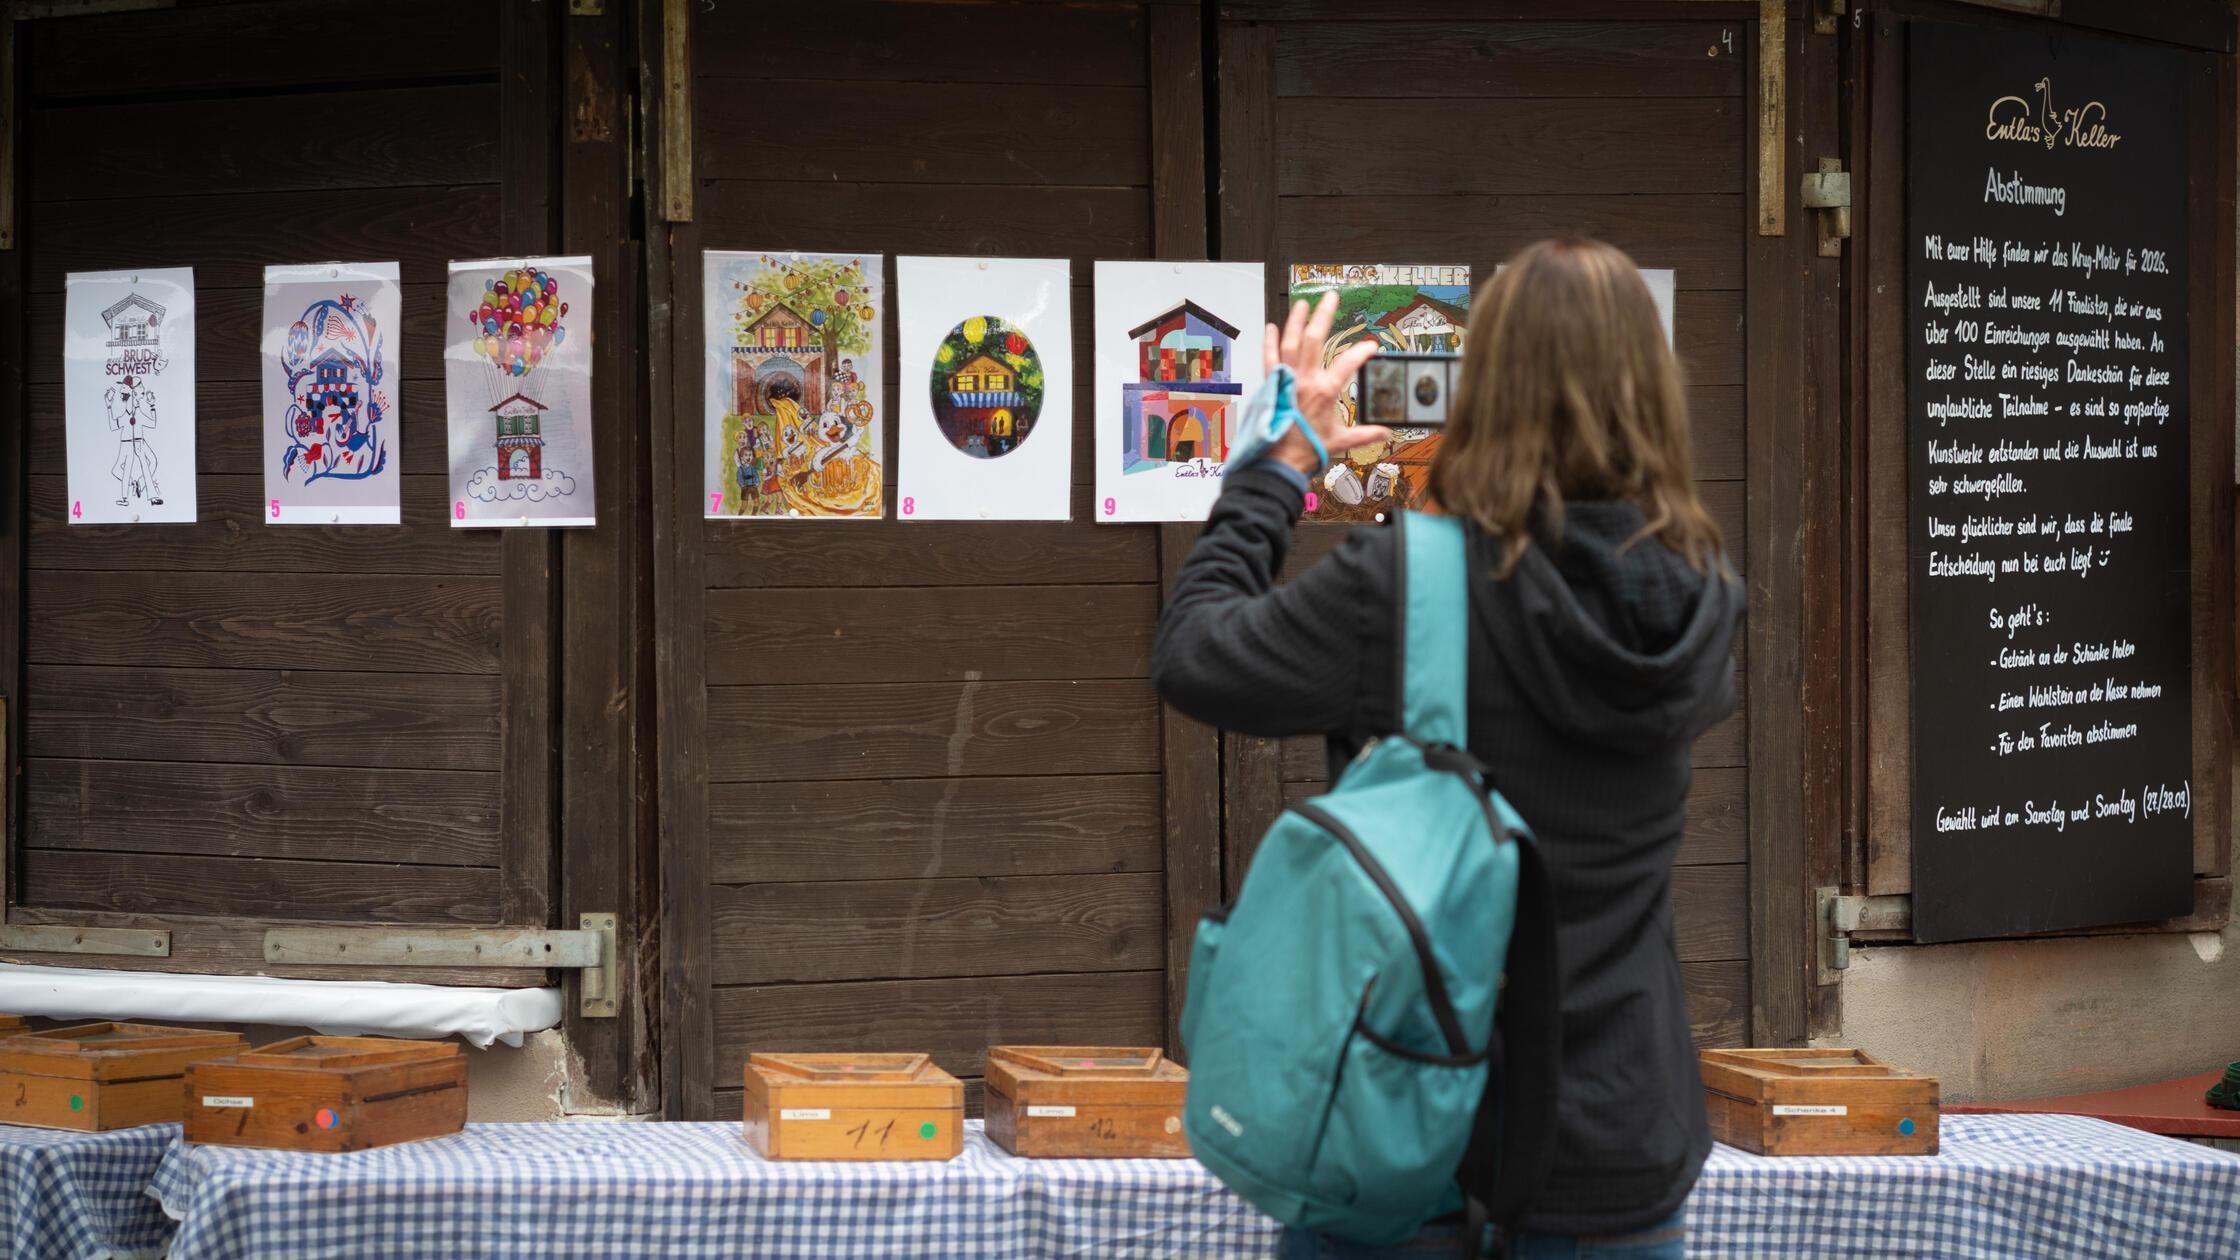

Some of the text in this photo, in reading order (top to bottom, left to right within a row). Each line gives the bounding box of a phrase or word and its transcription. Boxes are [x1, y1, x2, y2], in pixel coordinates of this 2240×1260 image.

[1722, 28, 1733, 54] 4
[1987, 96, 2121, 148] Entla's Keller
[1985, 167, 2065, 216] Abstimmung
[1926, 235, 2168, 279] Mit eurer Hilfe finden wir das Krug-Motiv für 2026.
[1381, 266, 1470, 286] KELLER
[1924, 281, 2161, 323] Ausgestellt sind unsere 11 Finalisten, die wir aus
[1926, 320, 2164, 354] über 100 Einreichungen ausgewählt haben. An
[106, 362, 152, 376] SCHWEST
[1926, 354, 2169, 391] dieser Stelle ein riesiges Dankeschön für diese
[1927, 394, 1992, 427] unglaubliche
[1999, 393, 2048, 418] Teilnahme
[2070, 402, 2081, 416] es
[2085, 397, 2105, 416] sind
[2109, 402, 2119, 416] so
[2124, 396, 2169, 426] großartige
[1928, 434, 2157, 464] Kunstwerke entstanden und die Auswahl ist uns
[1304, 491, 1318, 512] 0
[1929, 473, 2026, 501] sehr schwergefallen.
[73, 501, 82, 518] 4
[271, 499, 280, 518] 5
[455, 501, 465, 520] 6
[710, 493, 723, 513] 7
[903, 496, 914, 515] 8
[1104, 497, 1116, 515] 9
[1929, 511, 2132, 543] Umso glücklicher sind wir, dass die finale
[1929, 545, 2092, 582] Entscheidung nun bei euch liegt
[1990, 608, 2003, 629] So
[2000, 647, 2035, 669] Getränk
[2039, 653, 2050, 665] an
[2053, 644, 2068, 664] der
[2072, 642, 2109, 664] Schänke
[2112, 639, 2135, 659] holen
[1998, 692, 2024, 712] Einen
[2029, 684, 2073, 708] Wahlstein
[2075, 690, 2087, 704] an
[2090, 683, 2104, 702] der
[2106, 677, 2128, 701] Kasse
[2131, 681, 2161, 699] nehmen
[1998, 732, 2014, 756] Für
[2018, 731, 2035, 751] den
[2040, 722, 2082, 748] Favoriten
[2086, 720, 2137, 744] abstimmen
[1936, 806, 1976, 832] Gewählt
[1981, 805, 2000, 828] wird
[2005, 812, 2019, 826] am
[2025, 800, 2065, 832] Samstag
[2071, 800, 2090, 822] und
[2096, 789, 2135, 823] Sonntag
[846, 1119, 896, 1150] 11
